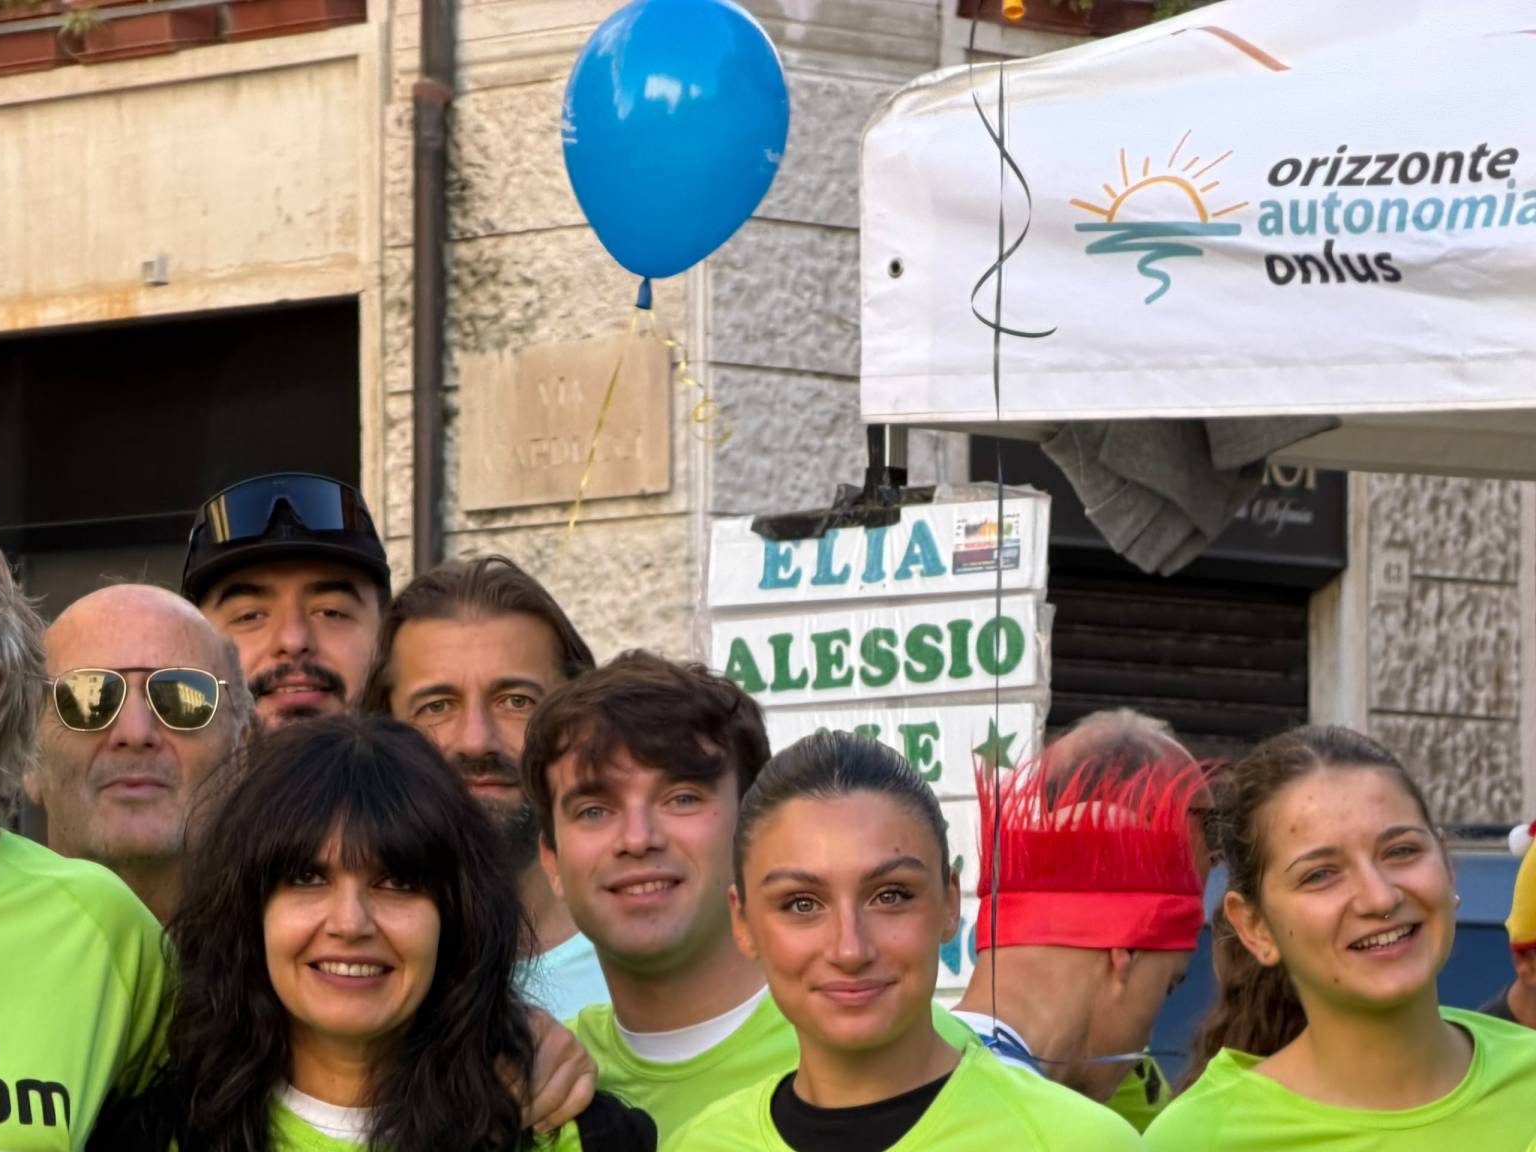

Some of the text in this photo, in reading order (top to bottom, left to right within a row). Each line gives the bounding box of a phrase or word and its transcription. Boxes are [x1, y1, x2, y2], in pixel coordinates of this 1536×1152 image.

[1267, 142, 1519, 187] orizzonte
[1258, 178, 1536, 236] autonomia
[1264, 239, 1402, 286] onlus
[758, 519, 947, 590] ELIA
[723, 615, 1026, 693] ALESSIO
